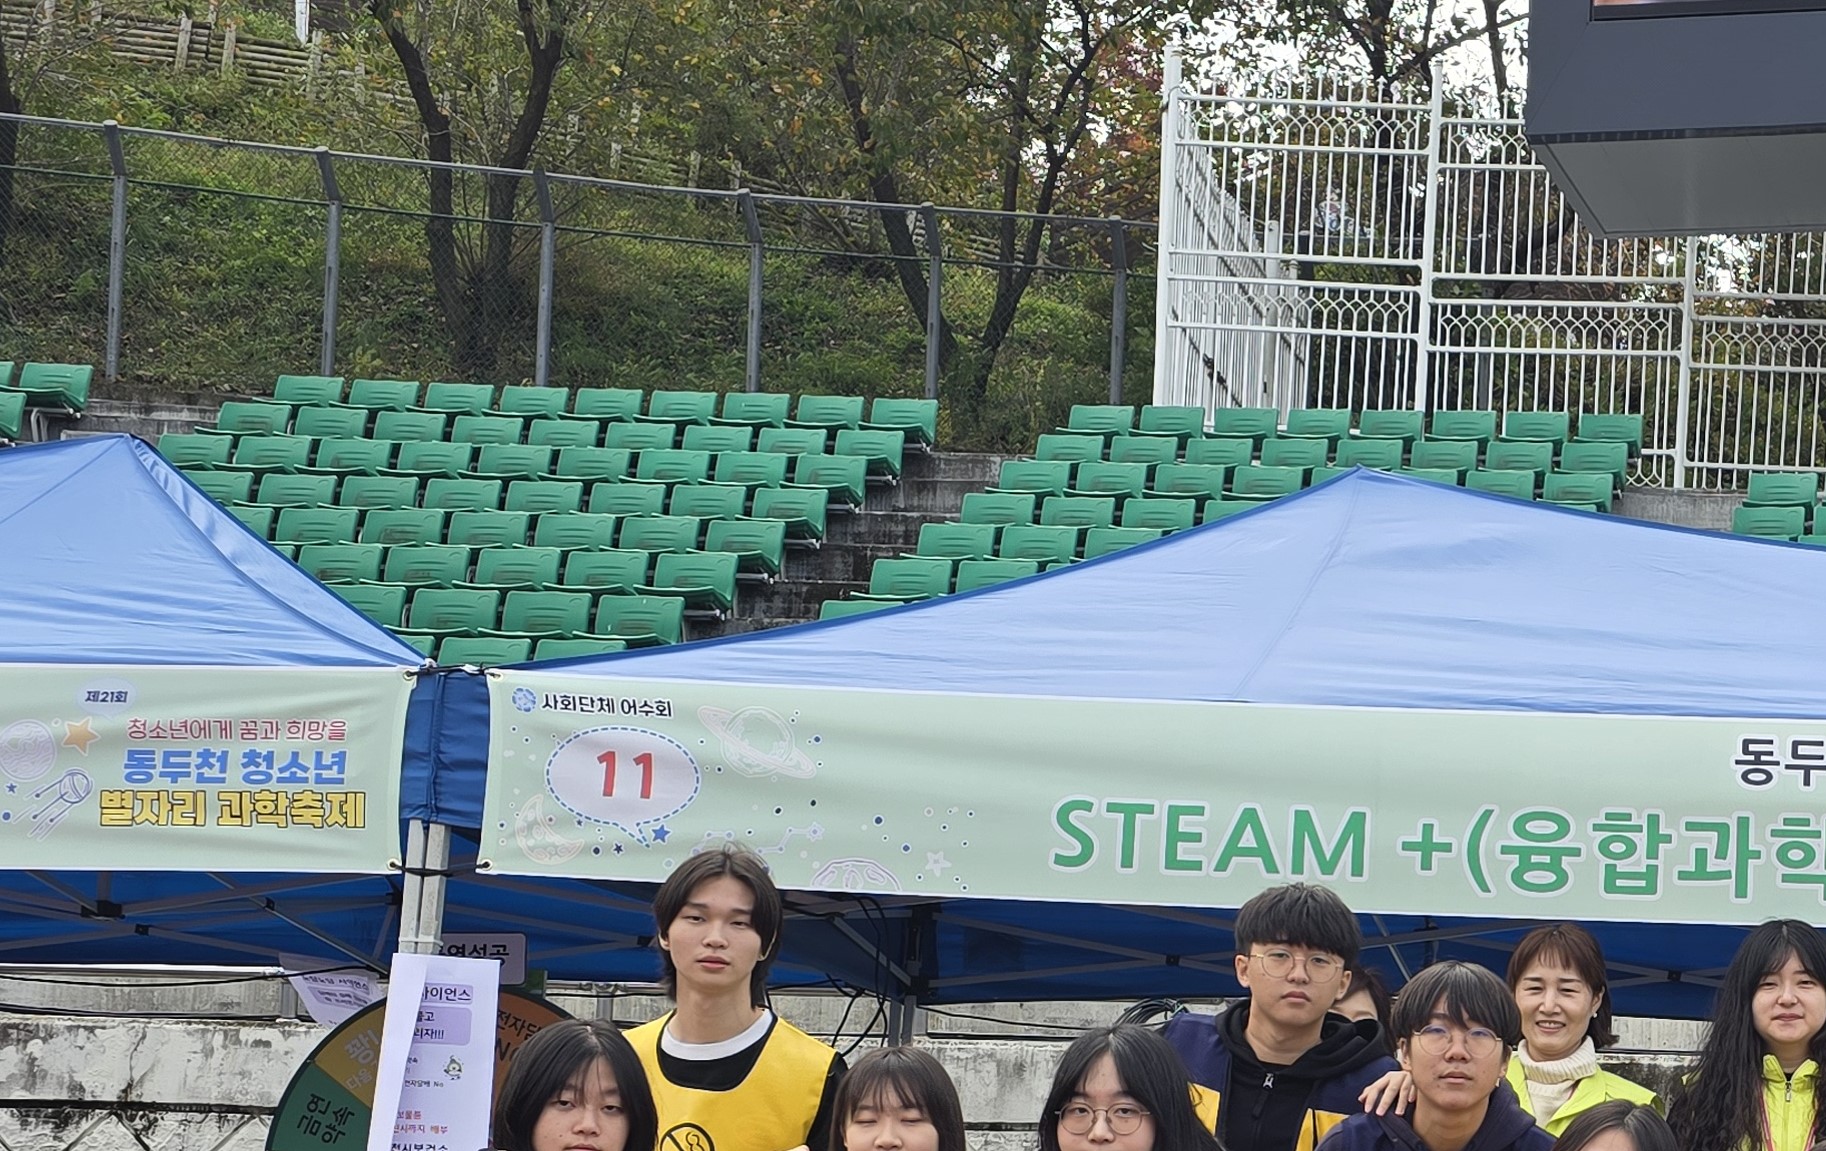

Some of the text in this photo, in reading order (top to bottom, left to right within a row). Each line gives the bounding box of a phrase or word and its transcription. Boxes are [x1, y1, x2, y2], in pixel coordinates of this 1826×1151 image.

[85, 691, 127, 704] 제21회
[542, 694, 672, 717] 사회단체 어수회
[127, 718, 347, 741] 청소년에게 꿈과 희망을
[123, 748, 347, 786] 동두천 청소년
[597, 751, 653, 799] 11
[100, 790, 366, 829] 별자리 과학축제
[1053, 799, 1367, 879] STEAM
[297, 1094, 331, 1136] 금연
[320, 1104, 356, 1145] 약속
